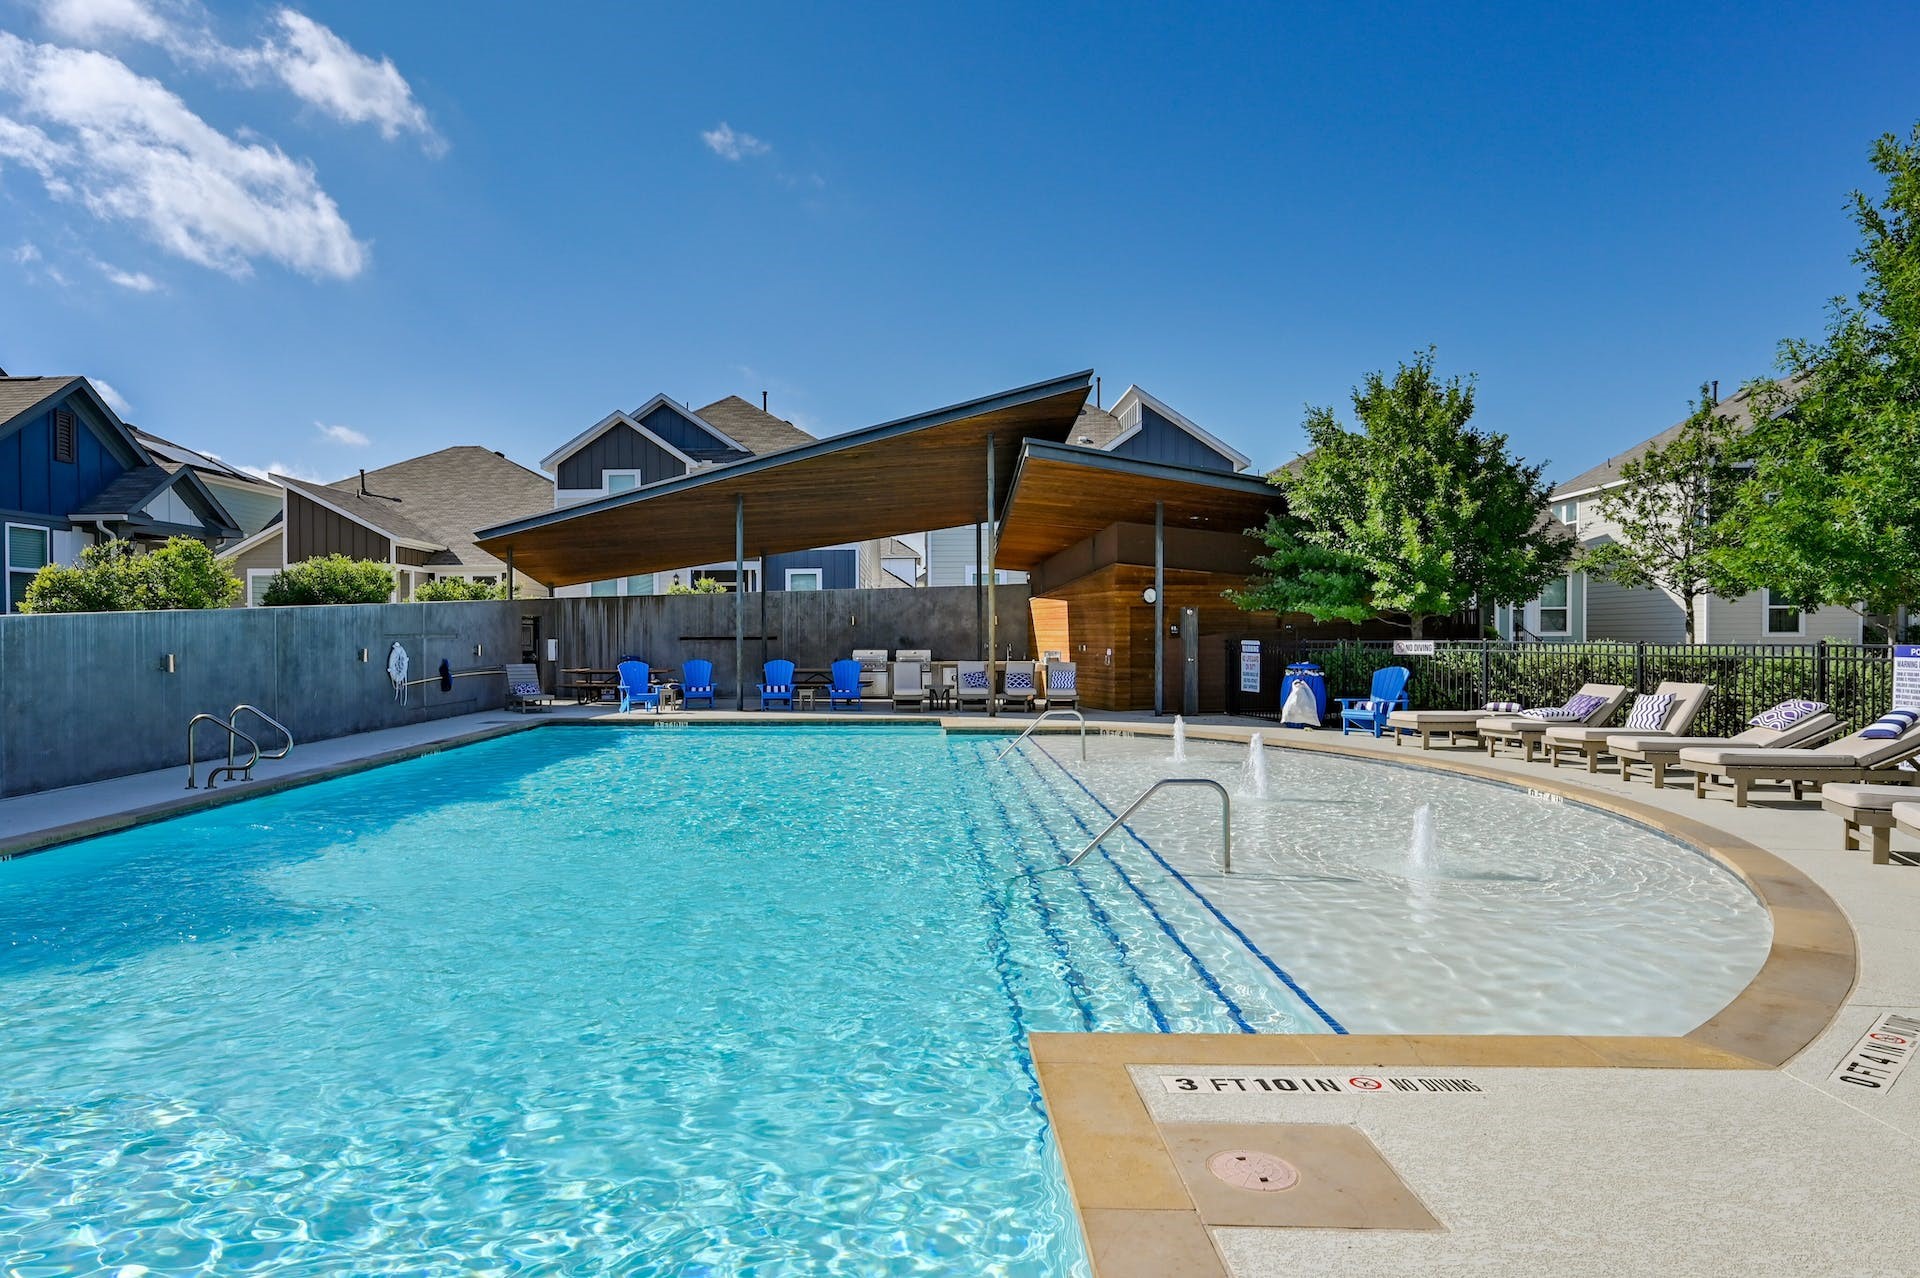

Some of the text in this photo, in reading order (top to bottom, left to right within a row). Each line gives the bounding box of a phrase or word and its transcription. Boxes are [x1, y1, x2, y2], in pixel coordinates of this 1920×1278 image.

[1414, 644, 1432, 652] DIVING
[1896, 661, 1918, 669] WARNING
[1863, 1041, 1907, 1058] IN
[1858, 1053, 1899, 1066] 4
[1846, 1061, 1891, 1081] FT
[1175, 1078, 1342, 1092] 3 FT 10 IN
[1388, 1078, 1482, 1092] NO DIVING
